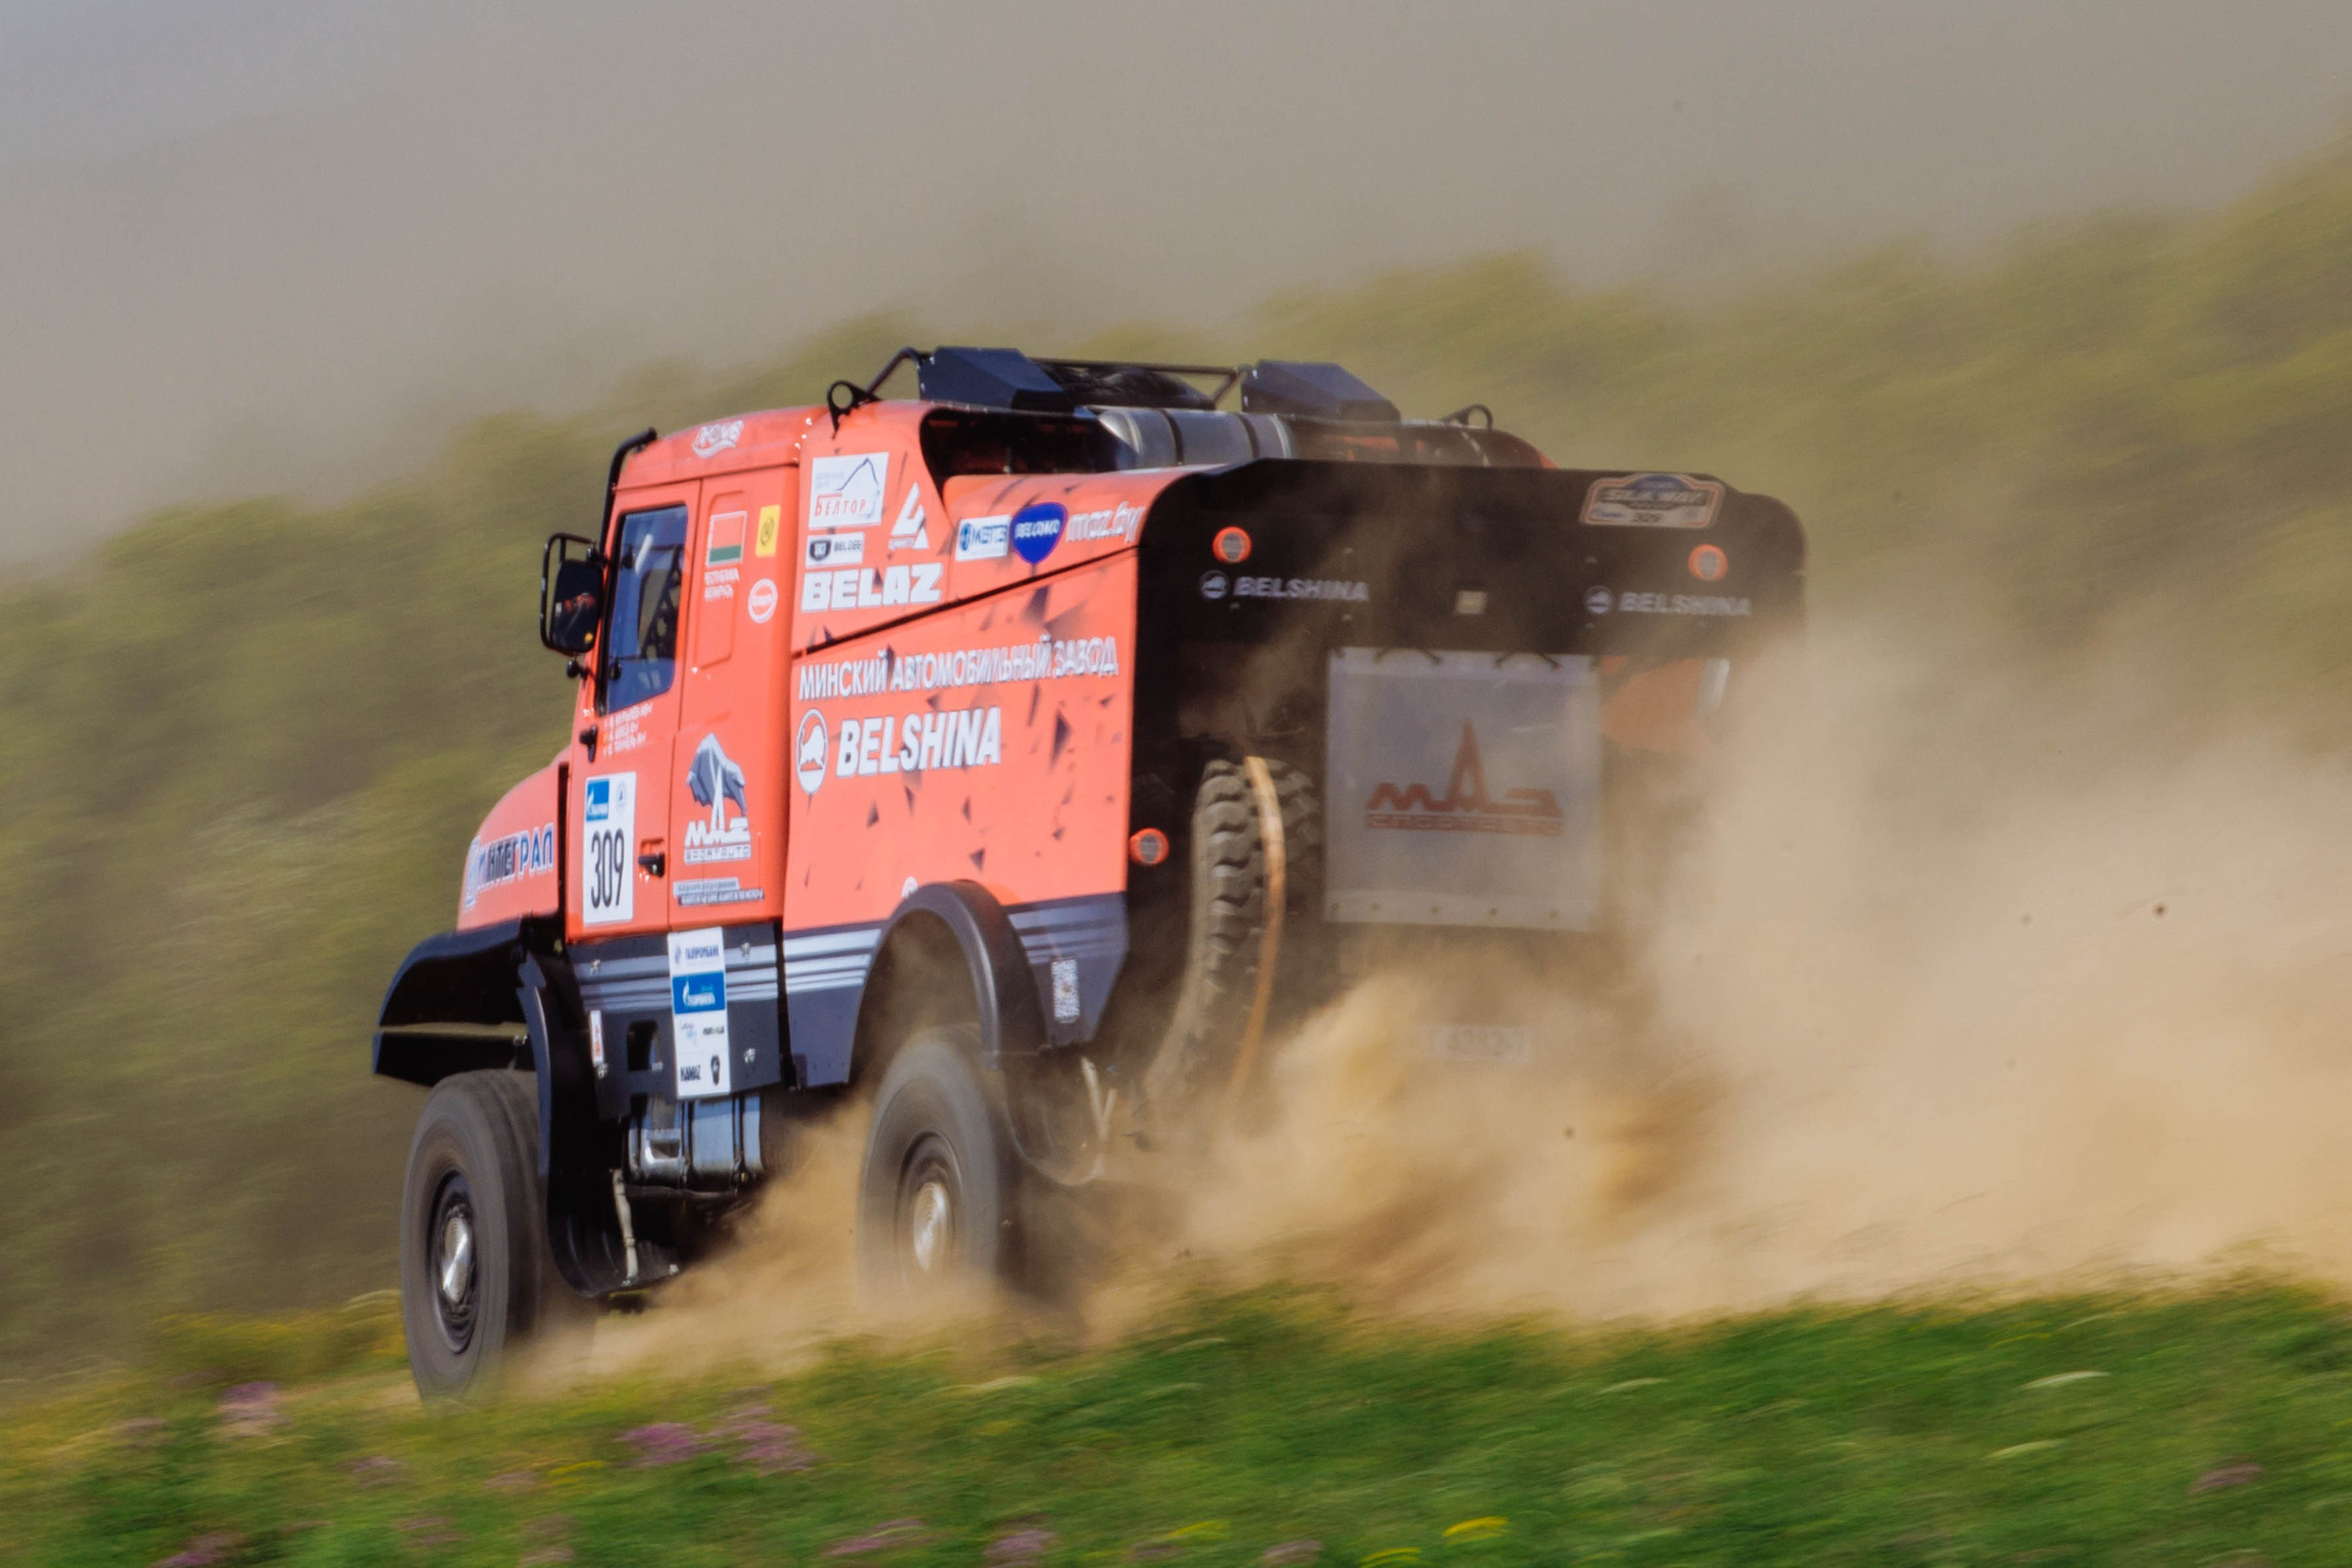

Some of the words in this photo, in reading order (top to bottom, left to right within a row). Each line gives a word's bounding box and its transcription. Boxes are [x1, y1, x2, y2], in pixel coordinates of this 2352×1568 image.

[814, 492, 866, 517] БЕЛТОР
[800, 562, 944, 613] BELAZ
[1234, 576, 1369, 601] BELSHINA
[798, 650, 888, 701] МИНСКИЙ
[891, 634, 1051, 692] АВТОМОБИЛЬНЫЙ
[1053, 636, 1119, 677] ЗАВОД
[836, 706, 1001, 778] BELSHINA
[591, 828, 625, 908] 309
